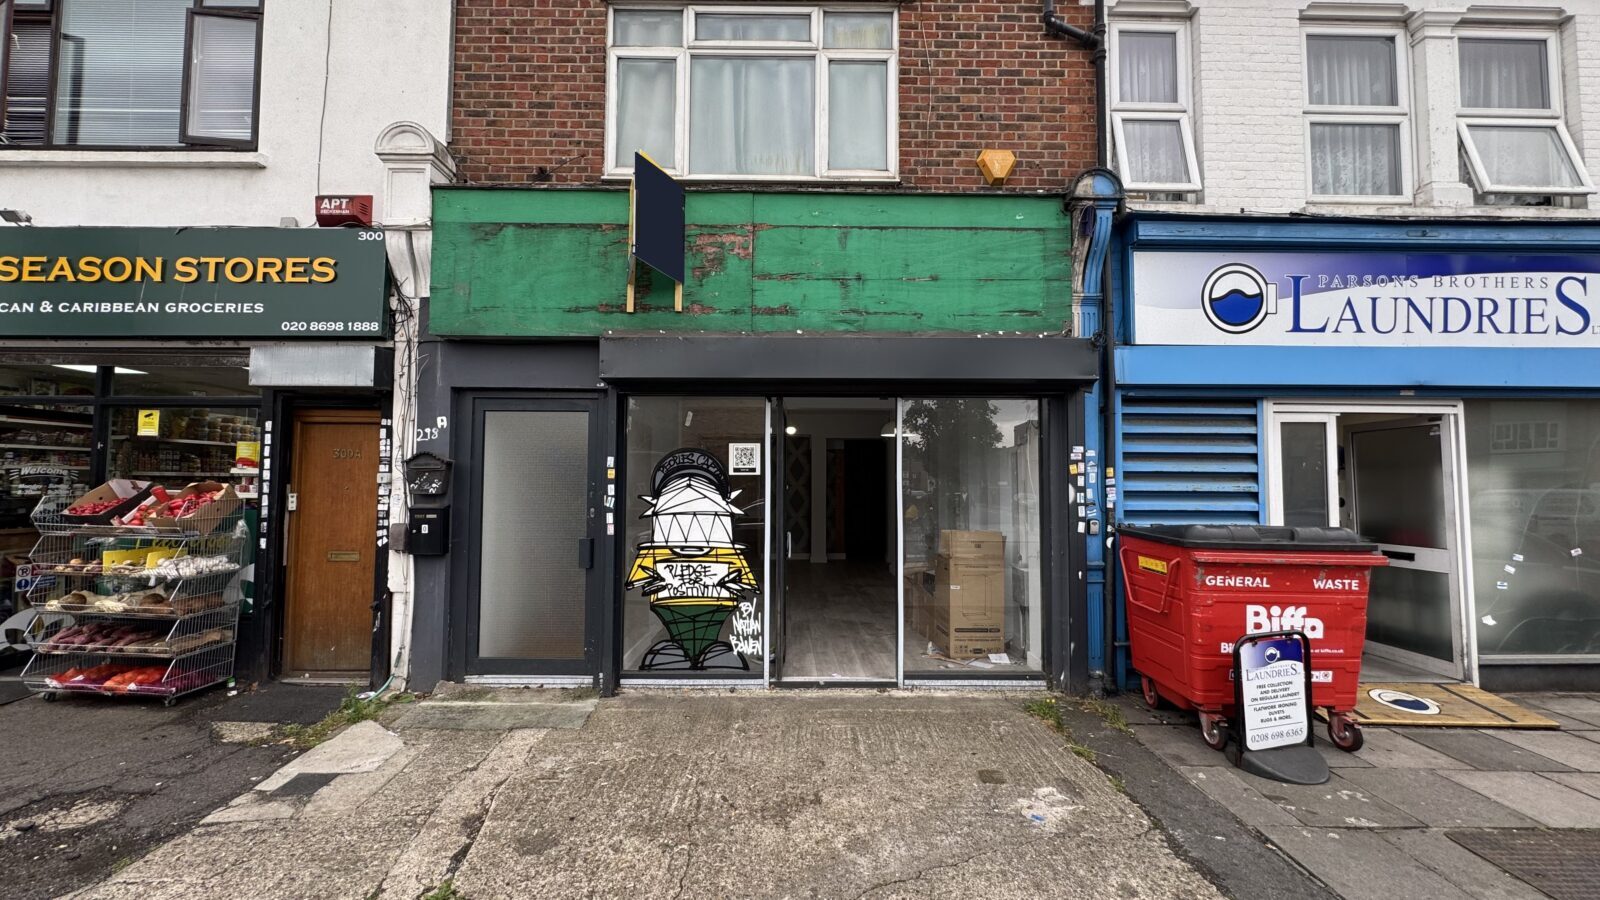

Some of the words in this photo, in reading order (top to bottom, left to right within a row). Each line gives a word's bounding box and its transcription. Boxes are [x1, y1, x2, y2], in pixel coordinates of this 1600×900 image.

[320, 198, 350, 209] APT
[358, 231, 384, 241] 300
[0, 256, 163, 282] SEASON
[174, 256, 337, 283] STORES
[1318, 274, 1419, 288] PARSONS
[1433, 275, 1550, 289] BROTHERS
[39, 300, 53, 313] &
[58, 302, 159, 313] CARIBBEAN
[165, 302, 264, 313] GROCERIES
[1284, 273, 1591, 336] LAUNDRIES
[281, 321, 307, 331] 020
[309, 321, 344, 331] 8698
[348, 321, 379, 331] 1888
[416, 427, 439, 441] 298
[20, 466, 69, 475] Welcome
[664, 563, 717, 579] PLEDGE
[1205, 575, 1270, 588] GENERAL
[1312, 578, 1360, 590] WASTE
[1246, 604, 1324, 639] Biffa
[1246, 663, 1298, 681] LAUNDRIES
[1259, 694, 1279, 702] REGULAR
[1250, 733, 1269, 743] 0208
[1270, 730, 1284, 740] 698
[1286, 727, 1303, 738] 6365
